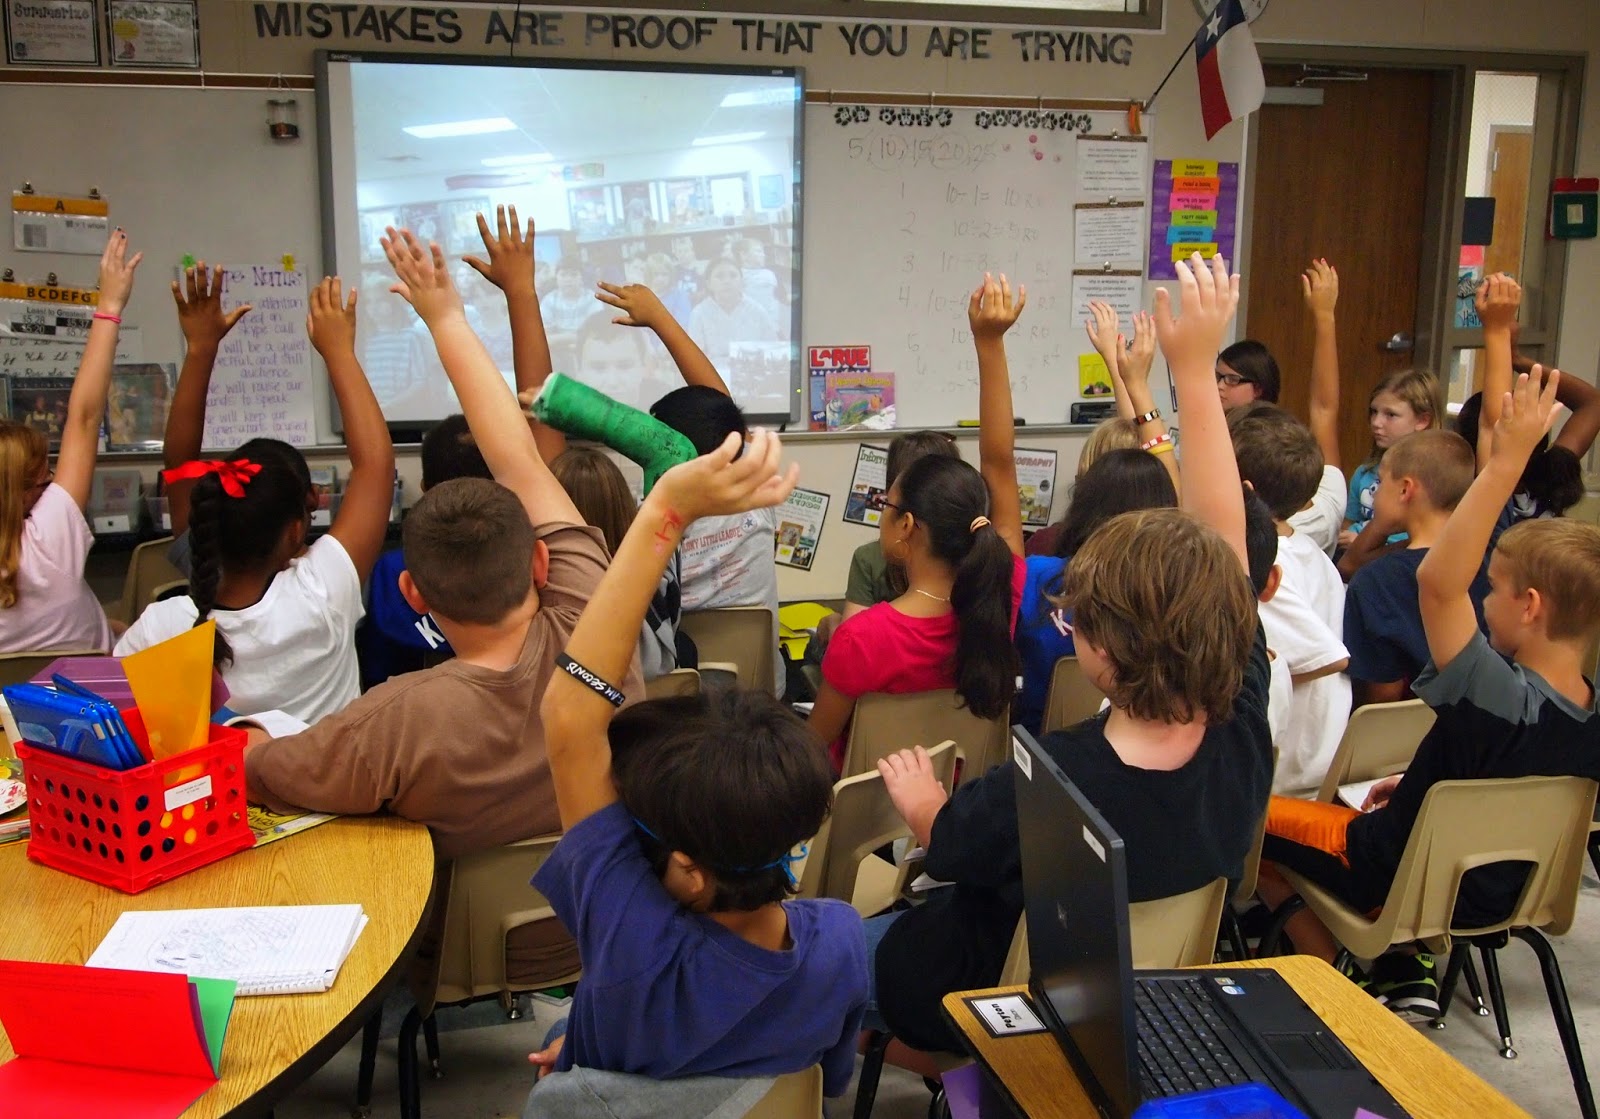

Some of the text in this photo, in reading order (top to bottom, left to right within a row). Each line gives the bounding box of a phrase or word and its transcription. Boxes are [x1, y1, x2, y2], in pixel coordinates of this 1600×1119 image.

[14, 2, 90, 20] Summarize
[254, 3, 1134, 66] MISTAKES ARE PROOF THAT YOU ARE TRYING
[977, 110, 1090, 133] BOBCATS
[55, 200, 65, 211] A
[27, 306, 87, 318] Least to Greatest
[813, 411, 826, 421] FOR
[1015, 456, 1054, 468] OGRAPHY
[700, 533, 718, 548] LITTLE
[719, 526, 742, 542] LEAGUE
[414, 616, 445, 649] K
[1050, 609, 1073, 636] K
[991, 1003, 1016, 1028] Peyton
